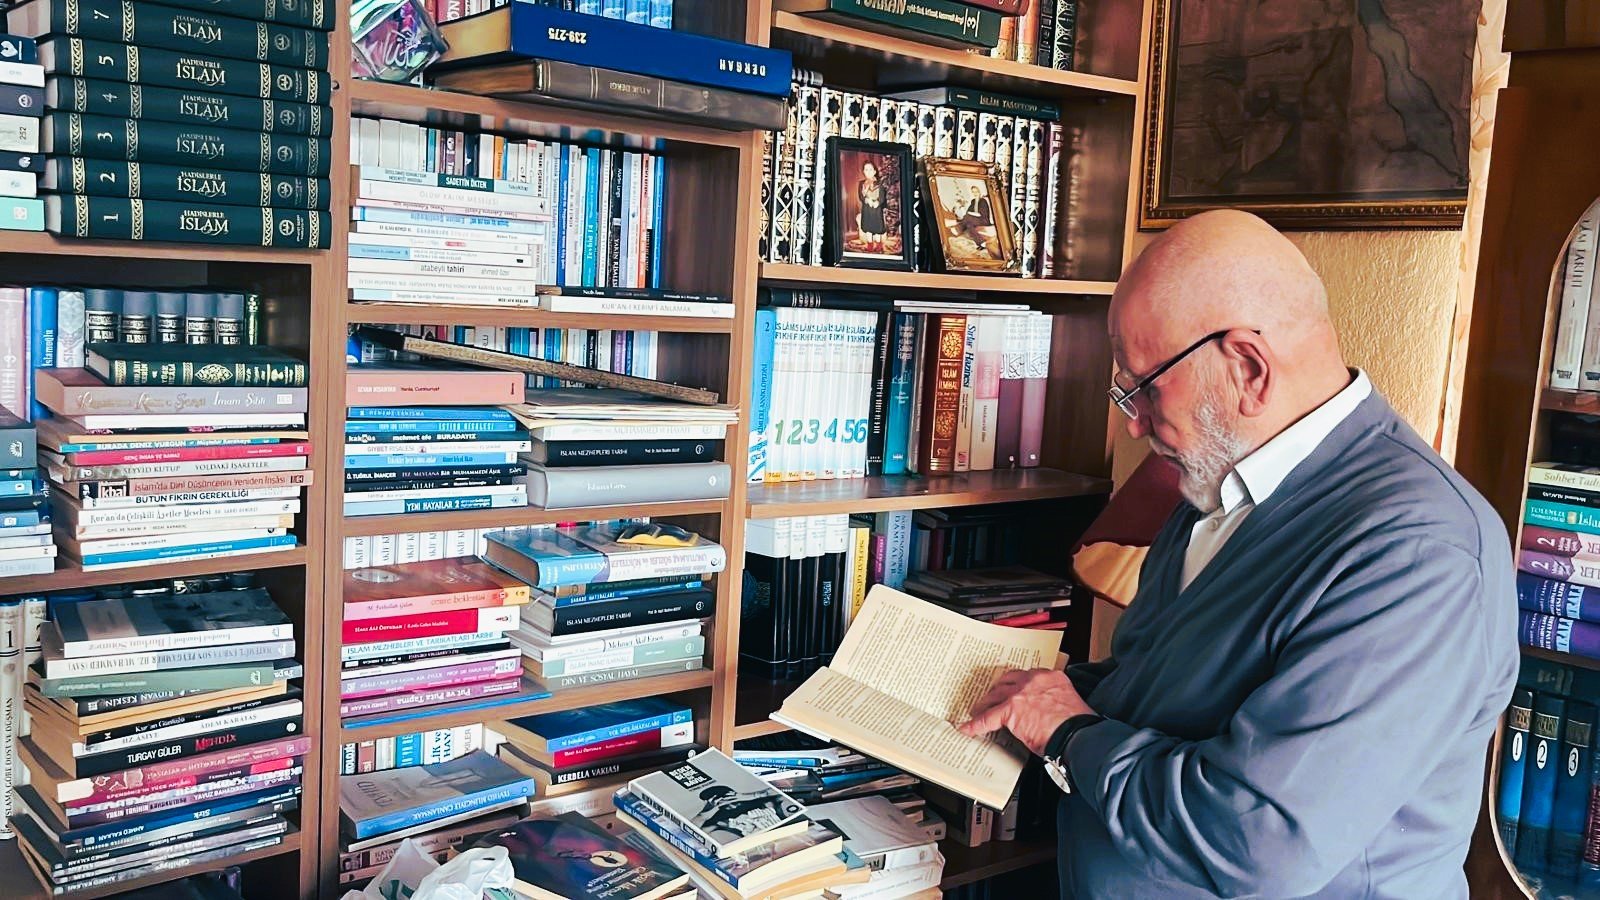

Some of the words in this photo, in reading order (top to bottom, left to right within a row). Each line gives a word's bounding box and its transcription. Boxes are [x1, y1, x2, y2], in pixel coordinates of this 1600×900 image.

[548, 28, 587, 44] 239-275
[98, 54, 114, 66] 5
[719, 58, 767, 77] DERGAH
[103, 93, 117, 103] 4
[97, 132, 113, 143] 3
[100, 171, 115, 184] 2
[103, 213, 119, 223] 1
[775, 420, 784, 445] 1
[787, 419, 803, 445] 2
[804, 419, 820, 444] 3
[824, 418, 838, 443] 4
[841, 419, 854, 443] 5
[854, 419, 867, 444] 6
[127, 749, 156, 764] TURGAY
[158, 744, 182, 758] GÜLER
[1538, 745, 1546, 764] 2
[1569, 752, 1577, 771] 3
[557, 770, 590, 784] KERBELA
